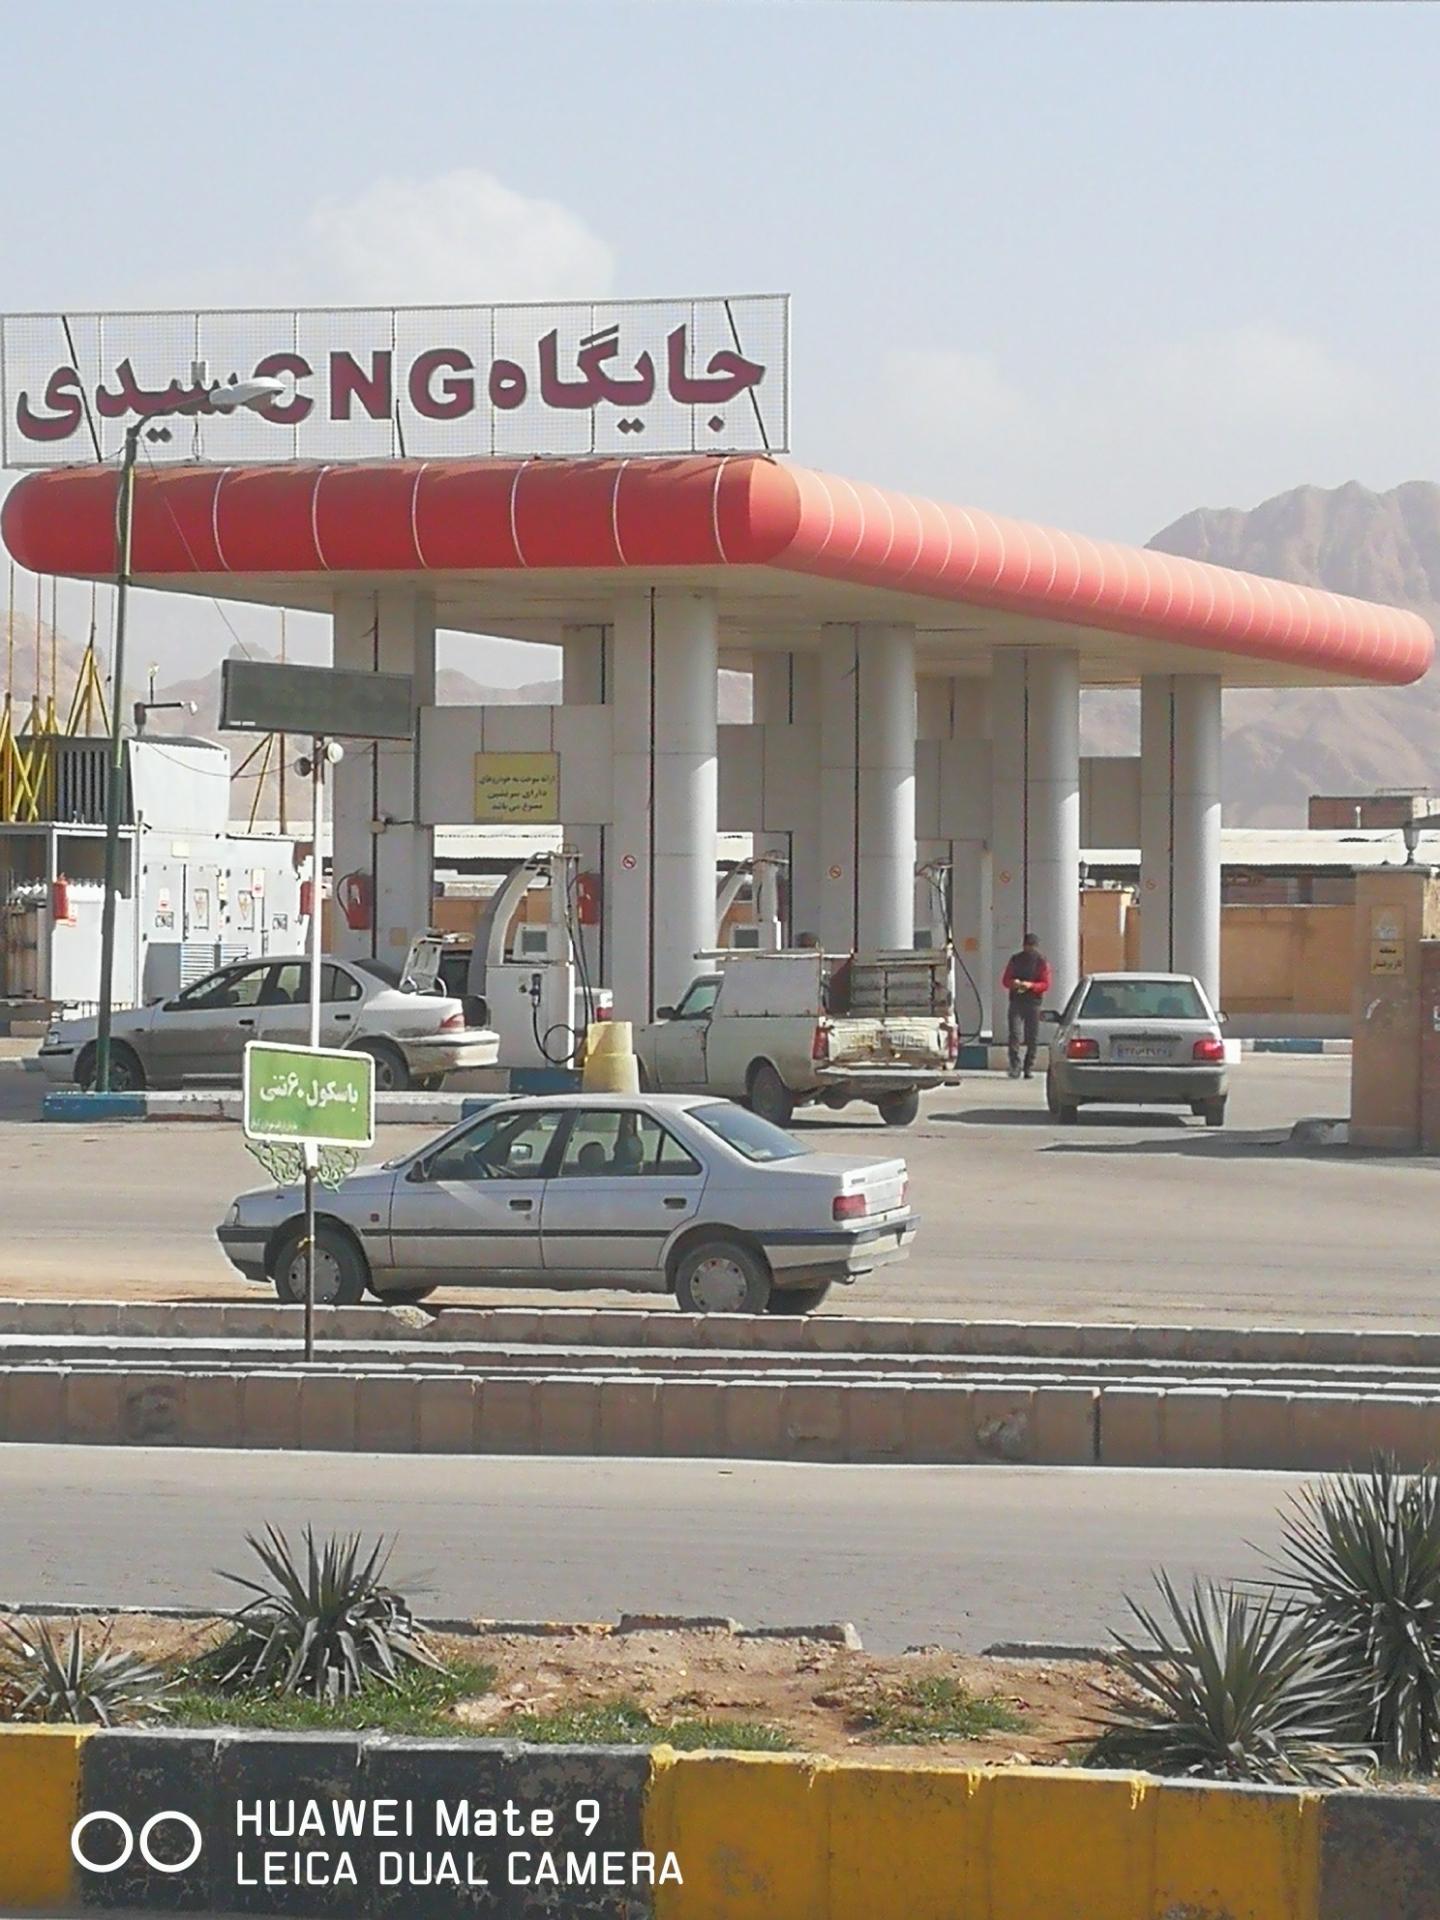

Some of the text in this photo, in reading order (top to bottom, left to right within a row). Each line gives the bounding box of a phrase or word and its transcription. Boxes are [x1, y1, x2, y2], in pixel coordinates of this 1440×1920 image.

[252, 346, 476, 424] CNG
[489, 323, 766, 434] جایگاه
[306, 1079, 359, 1112] باسکول
